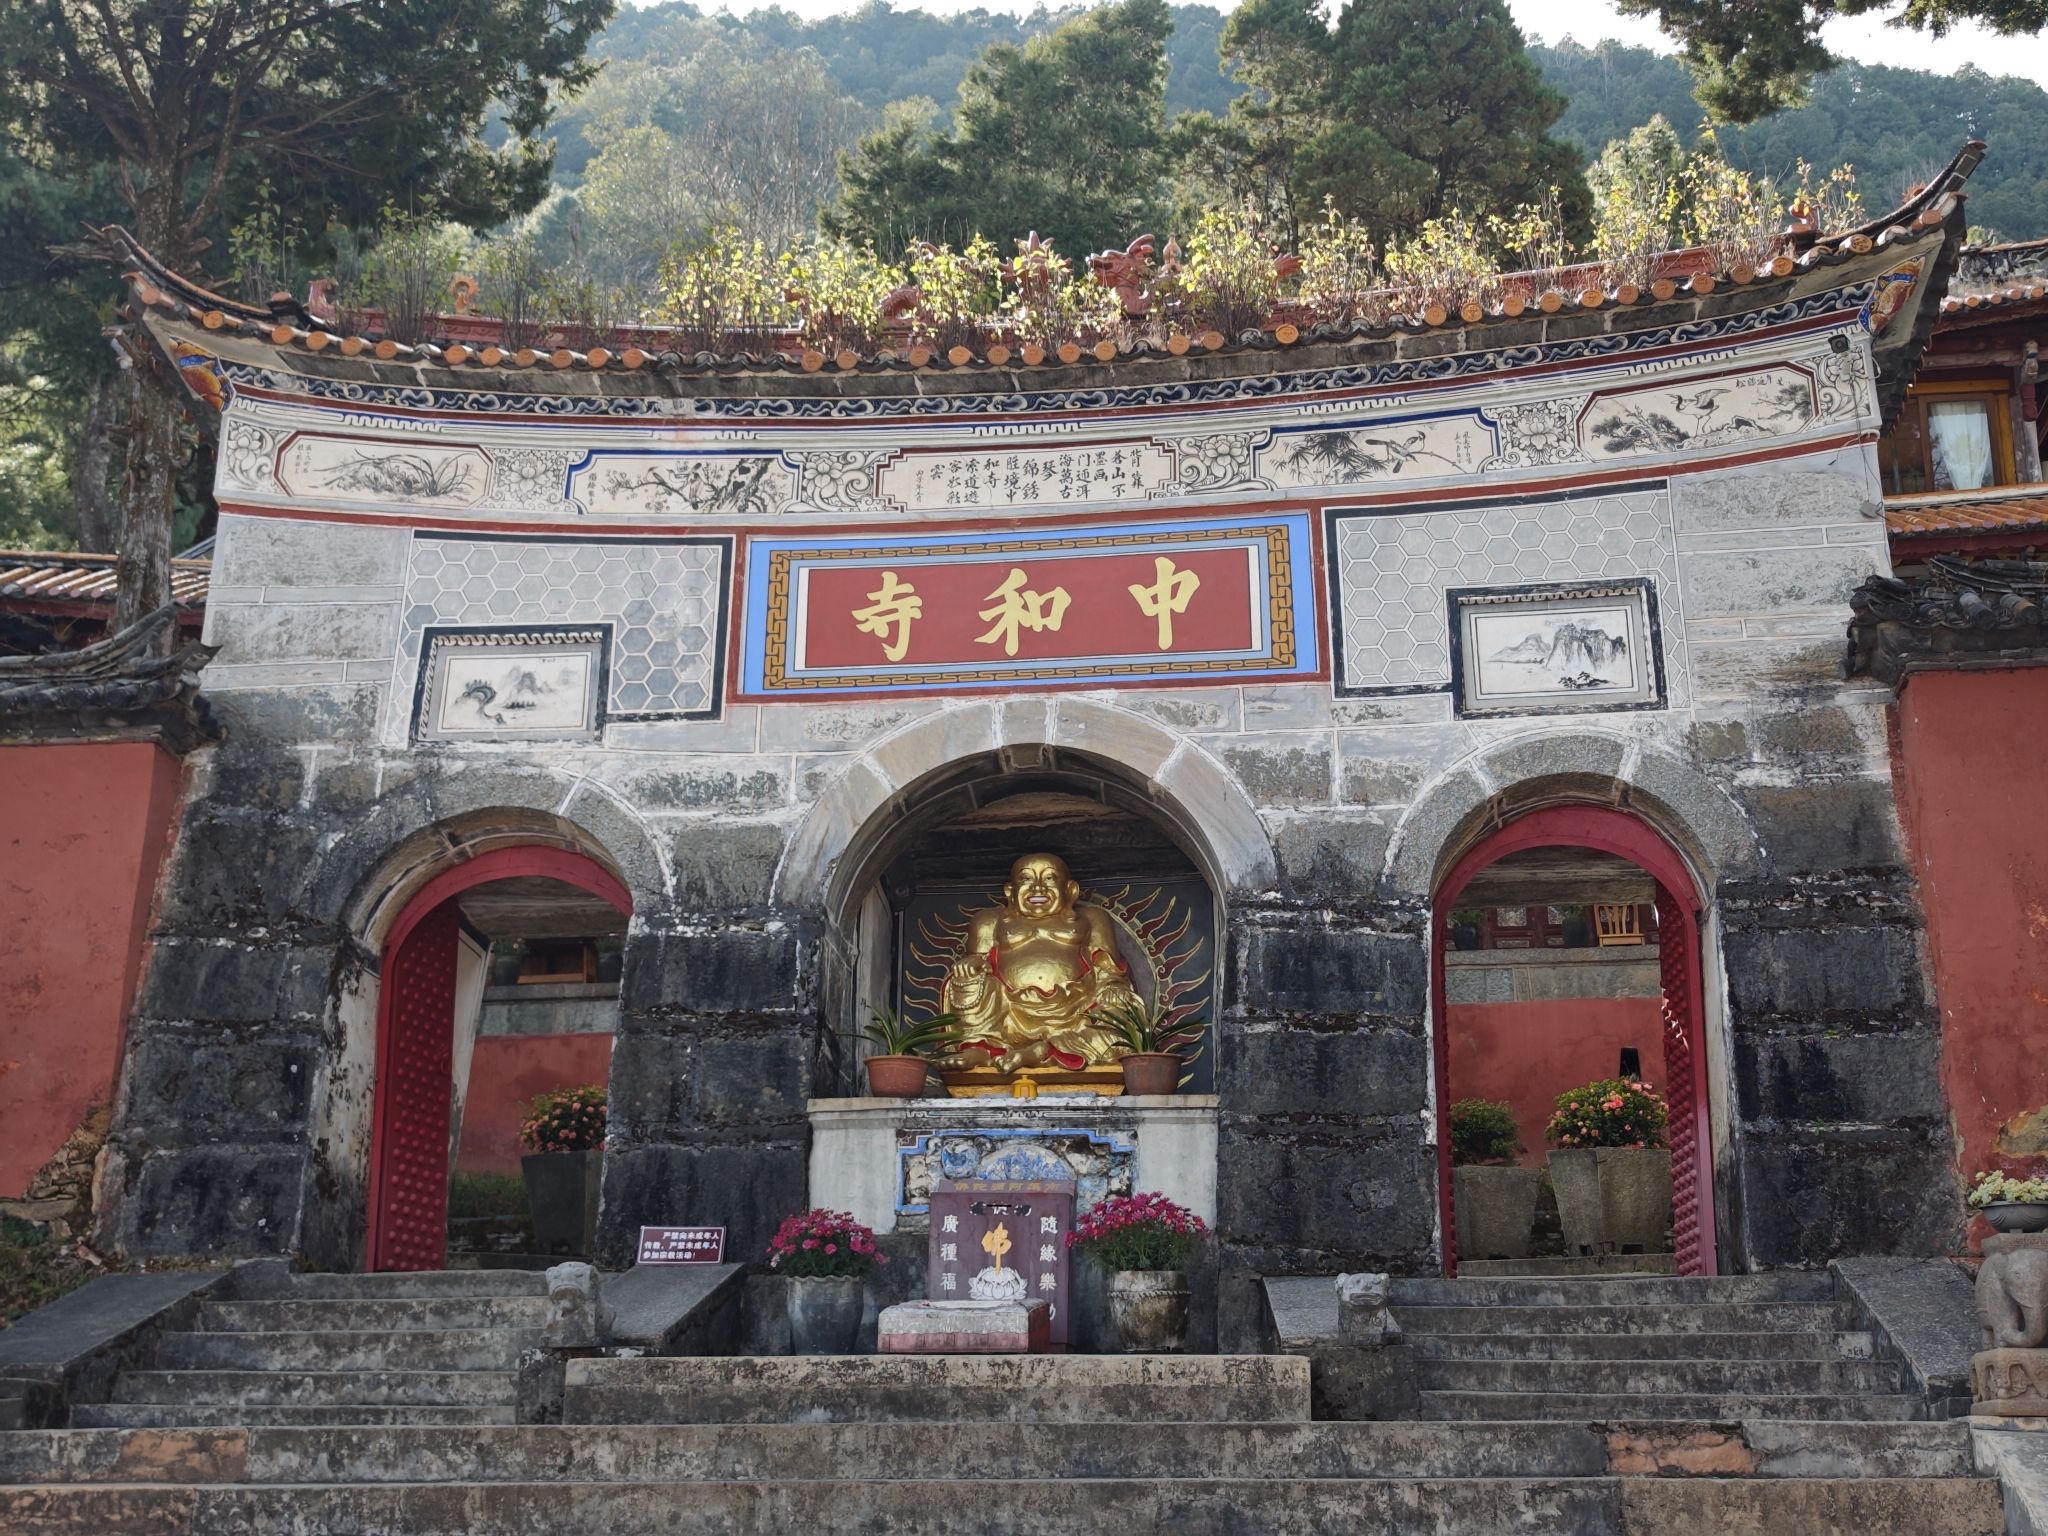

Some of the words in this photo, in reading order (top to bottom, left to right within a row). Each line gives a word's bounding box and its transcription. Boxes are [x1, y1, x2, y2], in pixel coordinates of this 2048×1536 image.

[984, 458, 1001, 488] 和寺
[1040, 460, 1058, 481] 琴
[1093, 451, 1108, 482] 墨画
[1130, 448, 1144, 489] 背靠
[851, 556, 1201, 662] 中和寺
[662, 1231, 719, 1240] 严禁向未成年人
[940, 1214, 959, 1291] 廣種福
